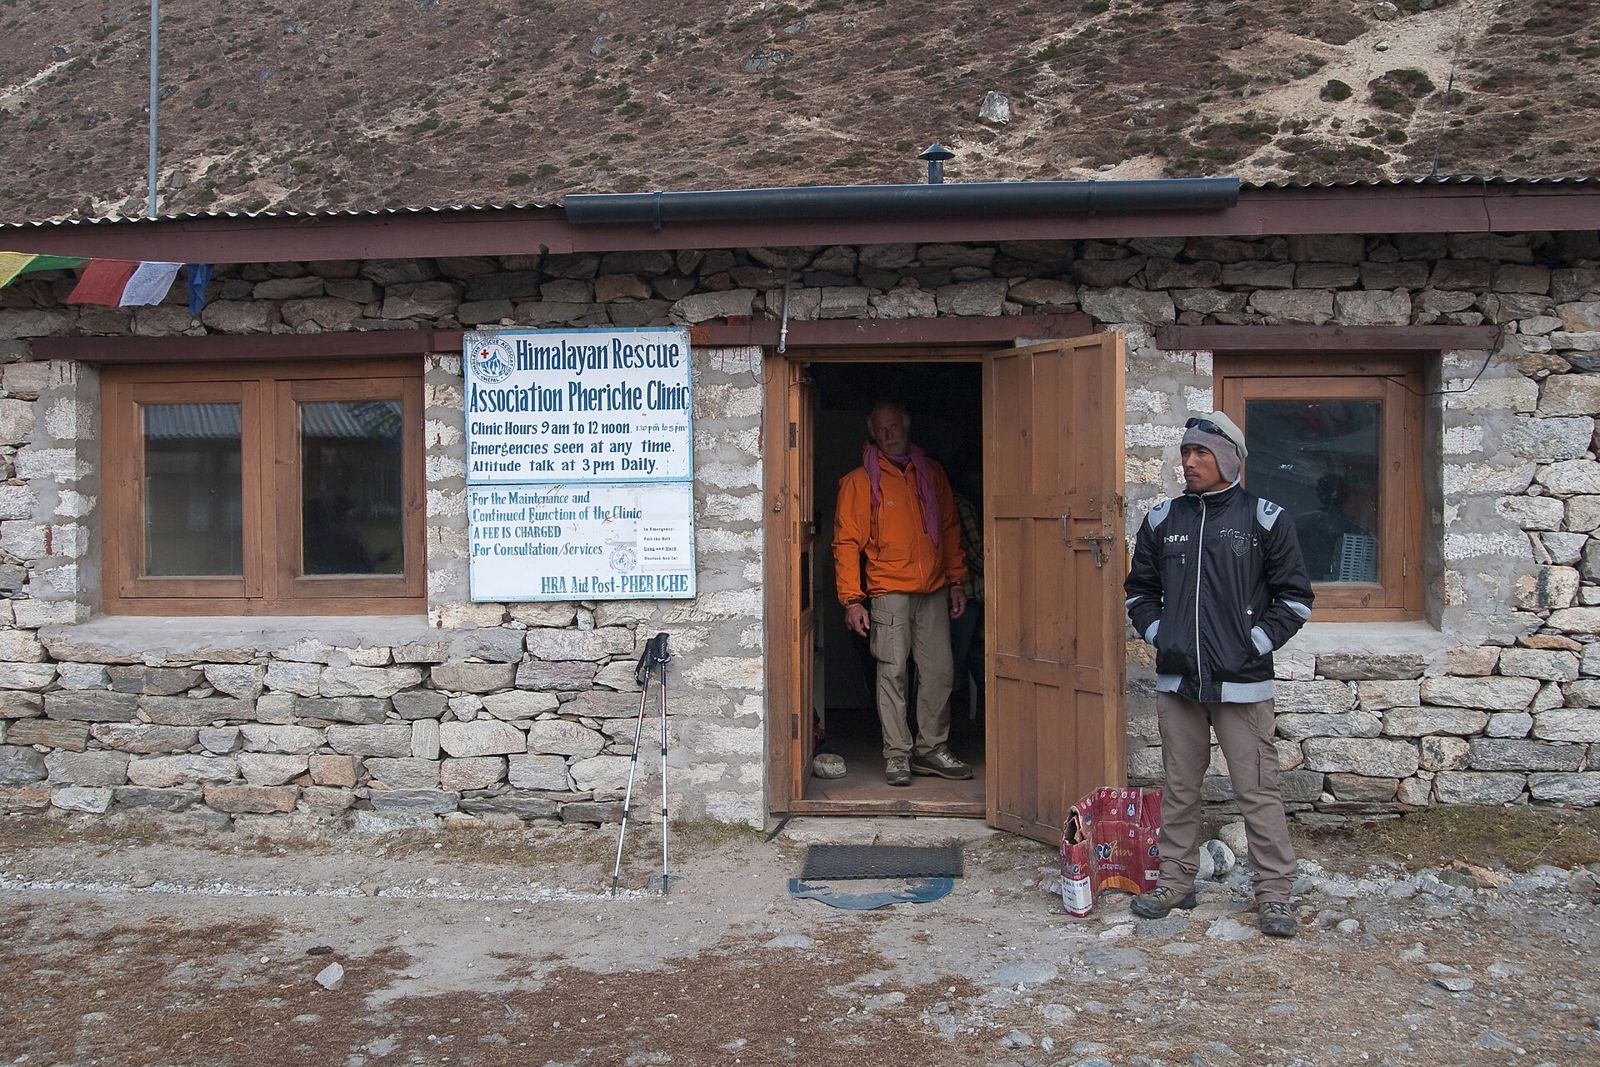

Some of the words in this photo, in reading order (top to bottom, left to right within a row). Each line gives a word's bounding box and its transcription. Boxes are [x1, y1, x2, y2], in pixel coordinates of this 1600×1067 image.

[516, 340, 609, 376] Himalayan
[612, 338, 680, 369] Rescue
[470, 382, 562, 412] Association
[568, 381, 642, 412] Pheriche
[646, 380, 690, 410] Clinic
[471, 422, 502, 435] Clinic
[505, 422, 538, 435] Hours
[541, 421, 550, 434] 9
[552, 424, 570, 434] am
[572, 421, 585, 434] to
[588, 421, 598, 434] 12
[471, 442, 549, 457] Emergencies
[554, 443, 584, 454] seen
[590, 440, 604, 453] at
[610, 442, 632, 456] any
[641, 440, 675, 453] time.
[472, 460, 522, 472] Altitude
[530, 460, 555, 471] talk
[562, 459, 576, 471] at
[582, 458, 590, 471] 3
[593, 460, 615, 474] pm
[621, 458, 659, 474] Daily.
[472, 492, 488, 505] For
[491, 492, 507, 504] the
[508, 492, 569, 504] Maintenance
[572, 490, 590, 503] and
[473, 508, 526, 522] Continued
[529, 507, 576, 520] Function
[578, 506, 591, 520] of
[593, 506, 610, 520] the
[613, 505, 642, 519] Clinic
[474, 527, 480, 540] A
[483, 526, 499, 539] FEE
[502, 526, 511, 539] IS
[514, 526, 562, 538] CHARGED
[474, 543, 491, 556] For
[541, 576, 567, 594] HRA
[570, 576, 589, 593] Aid
